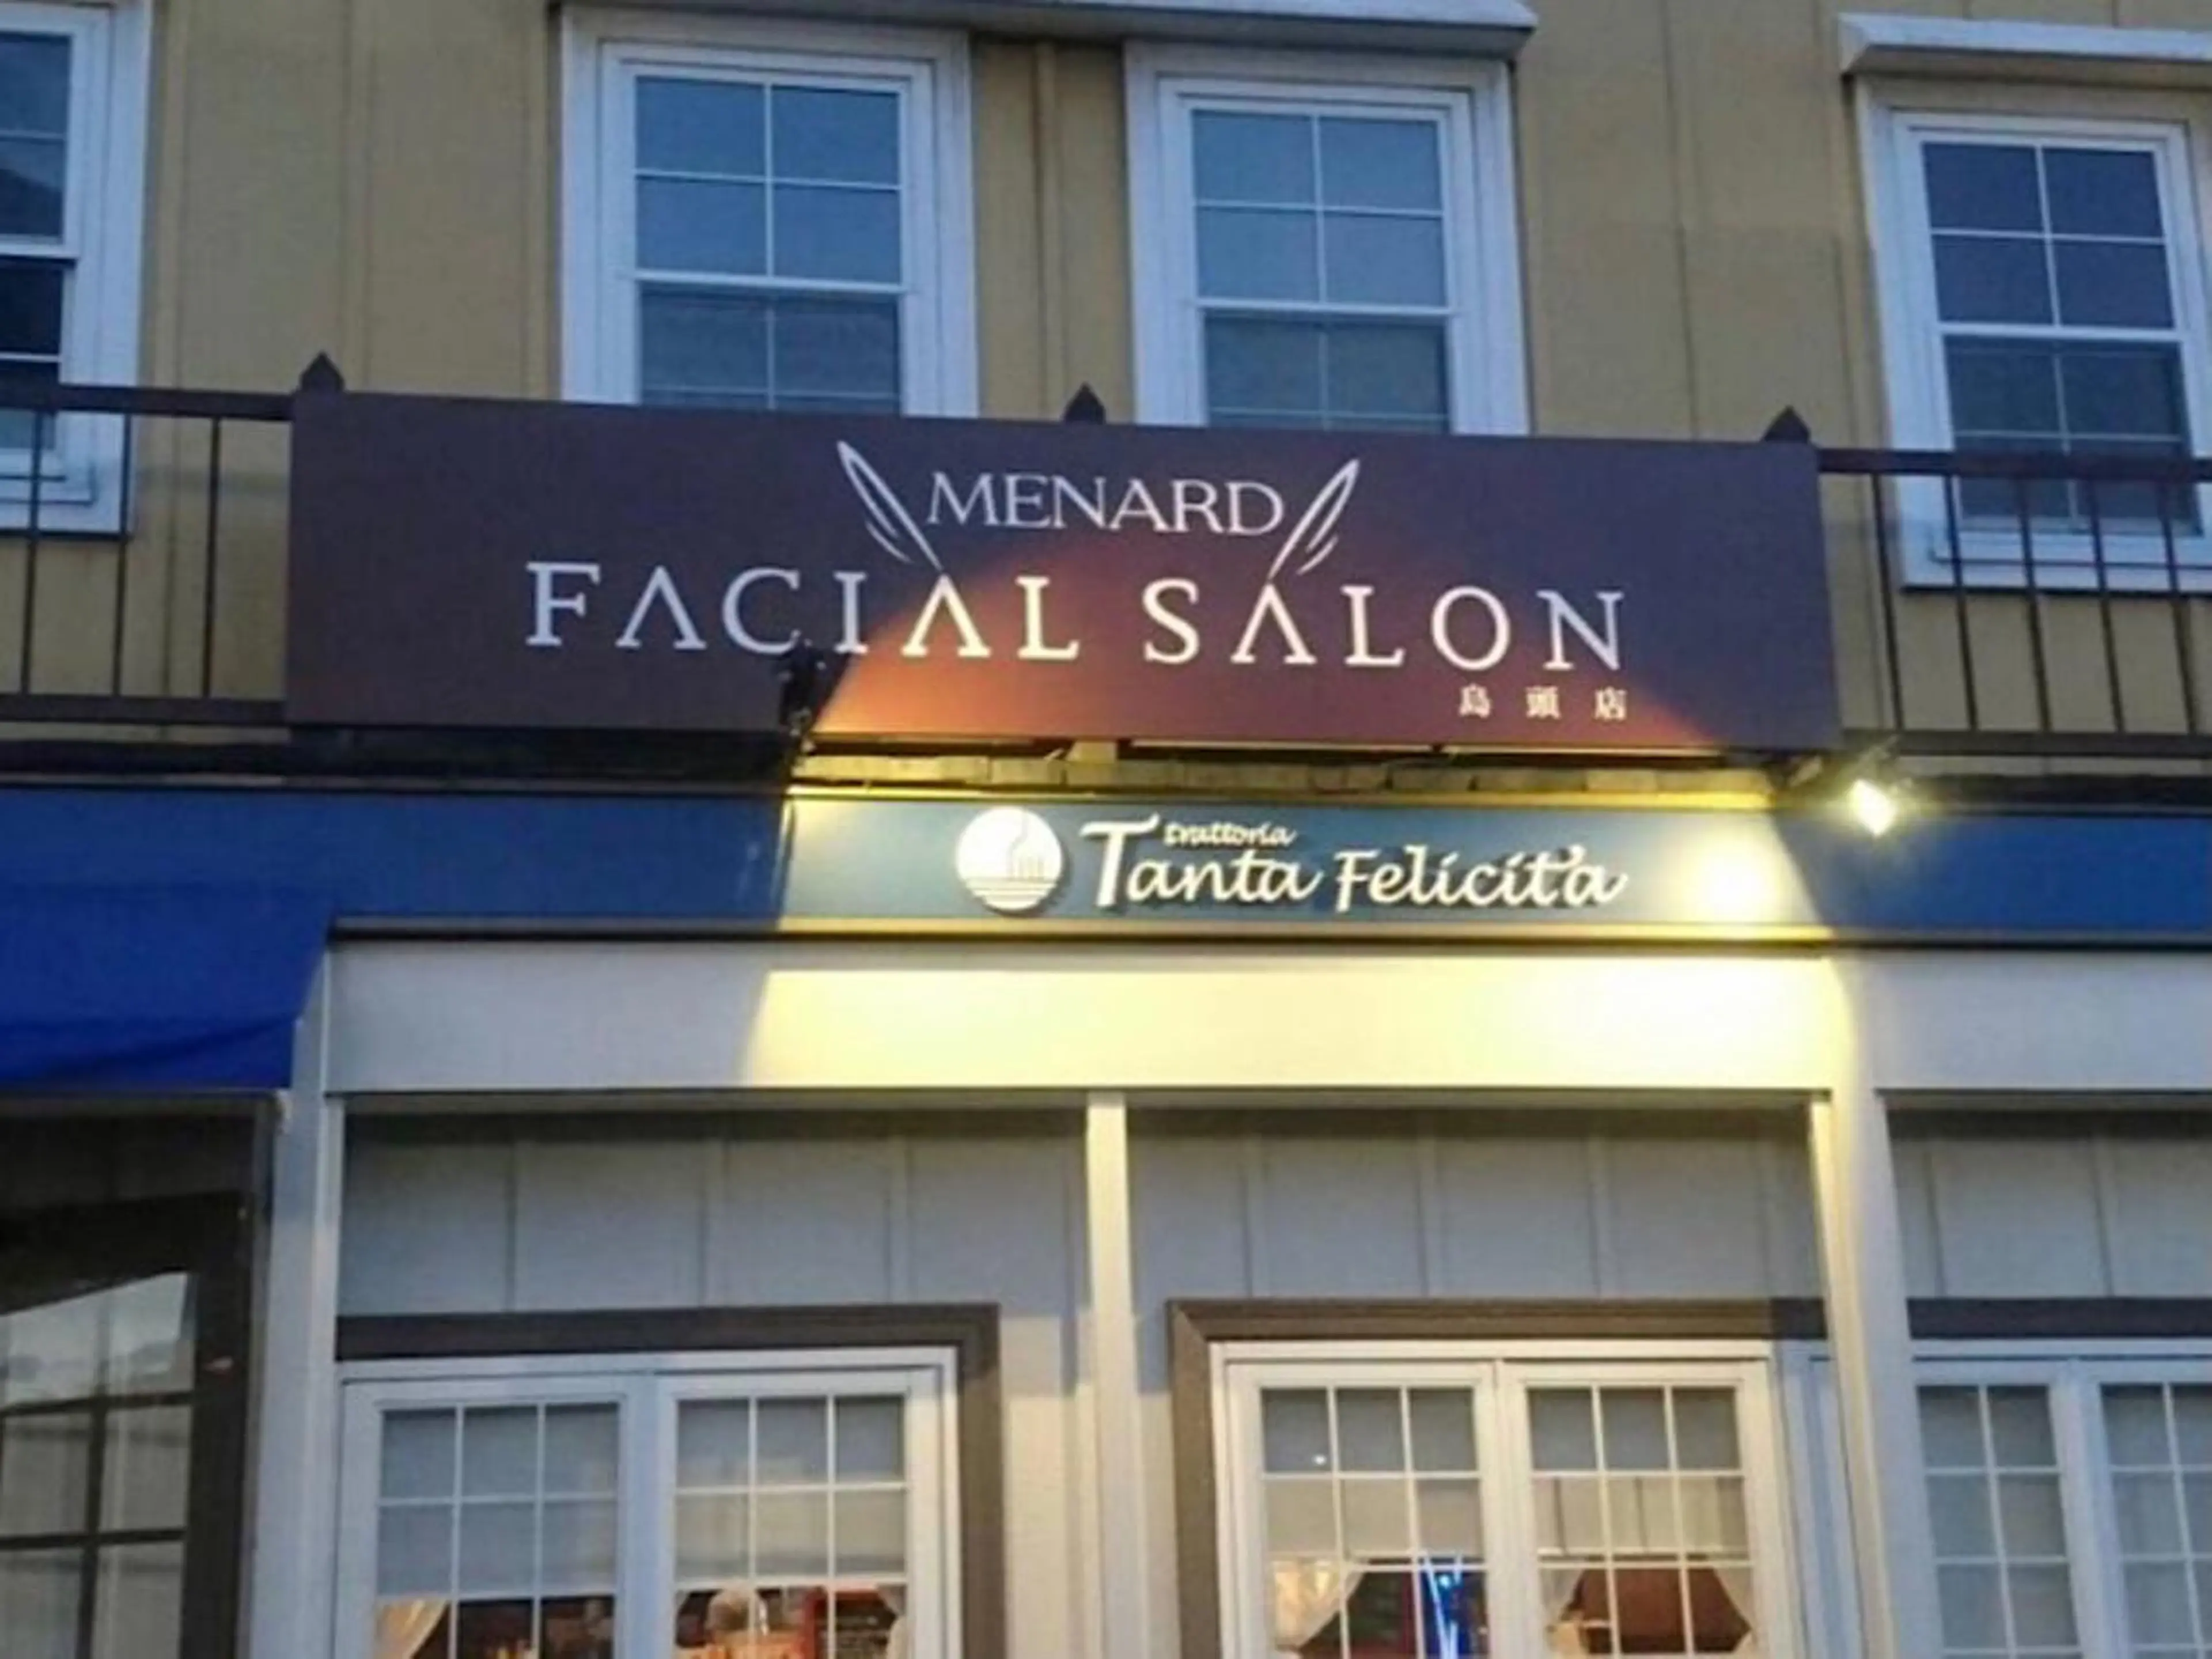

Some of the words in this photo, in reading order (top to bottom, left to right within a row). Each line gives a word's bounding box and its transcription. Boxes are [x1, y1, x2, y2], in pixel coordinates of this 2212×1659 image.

[926, 471, 1285, 536] MENARD
[526, 561, 1081, 659] FACIAL
[1141, 578, 1625, 671] SALON
[1078, 814, 1324, 907] Tanta
[1163, 821, 1298, 847] trattoria
